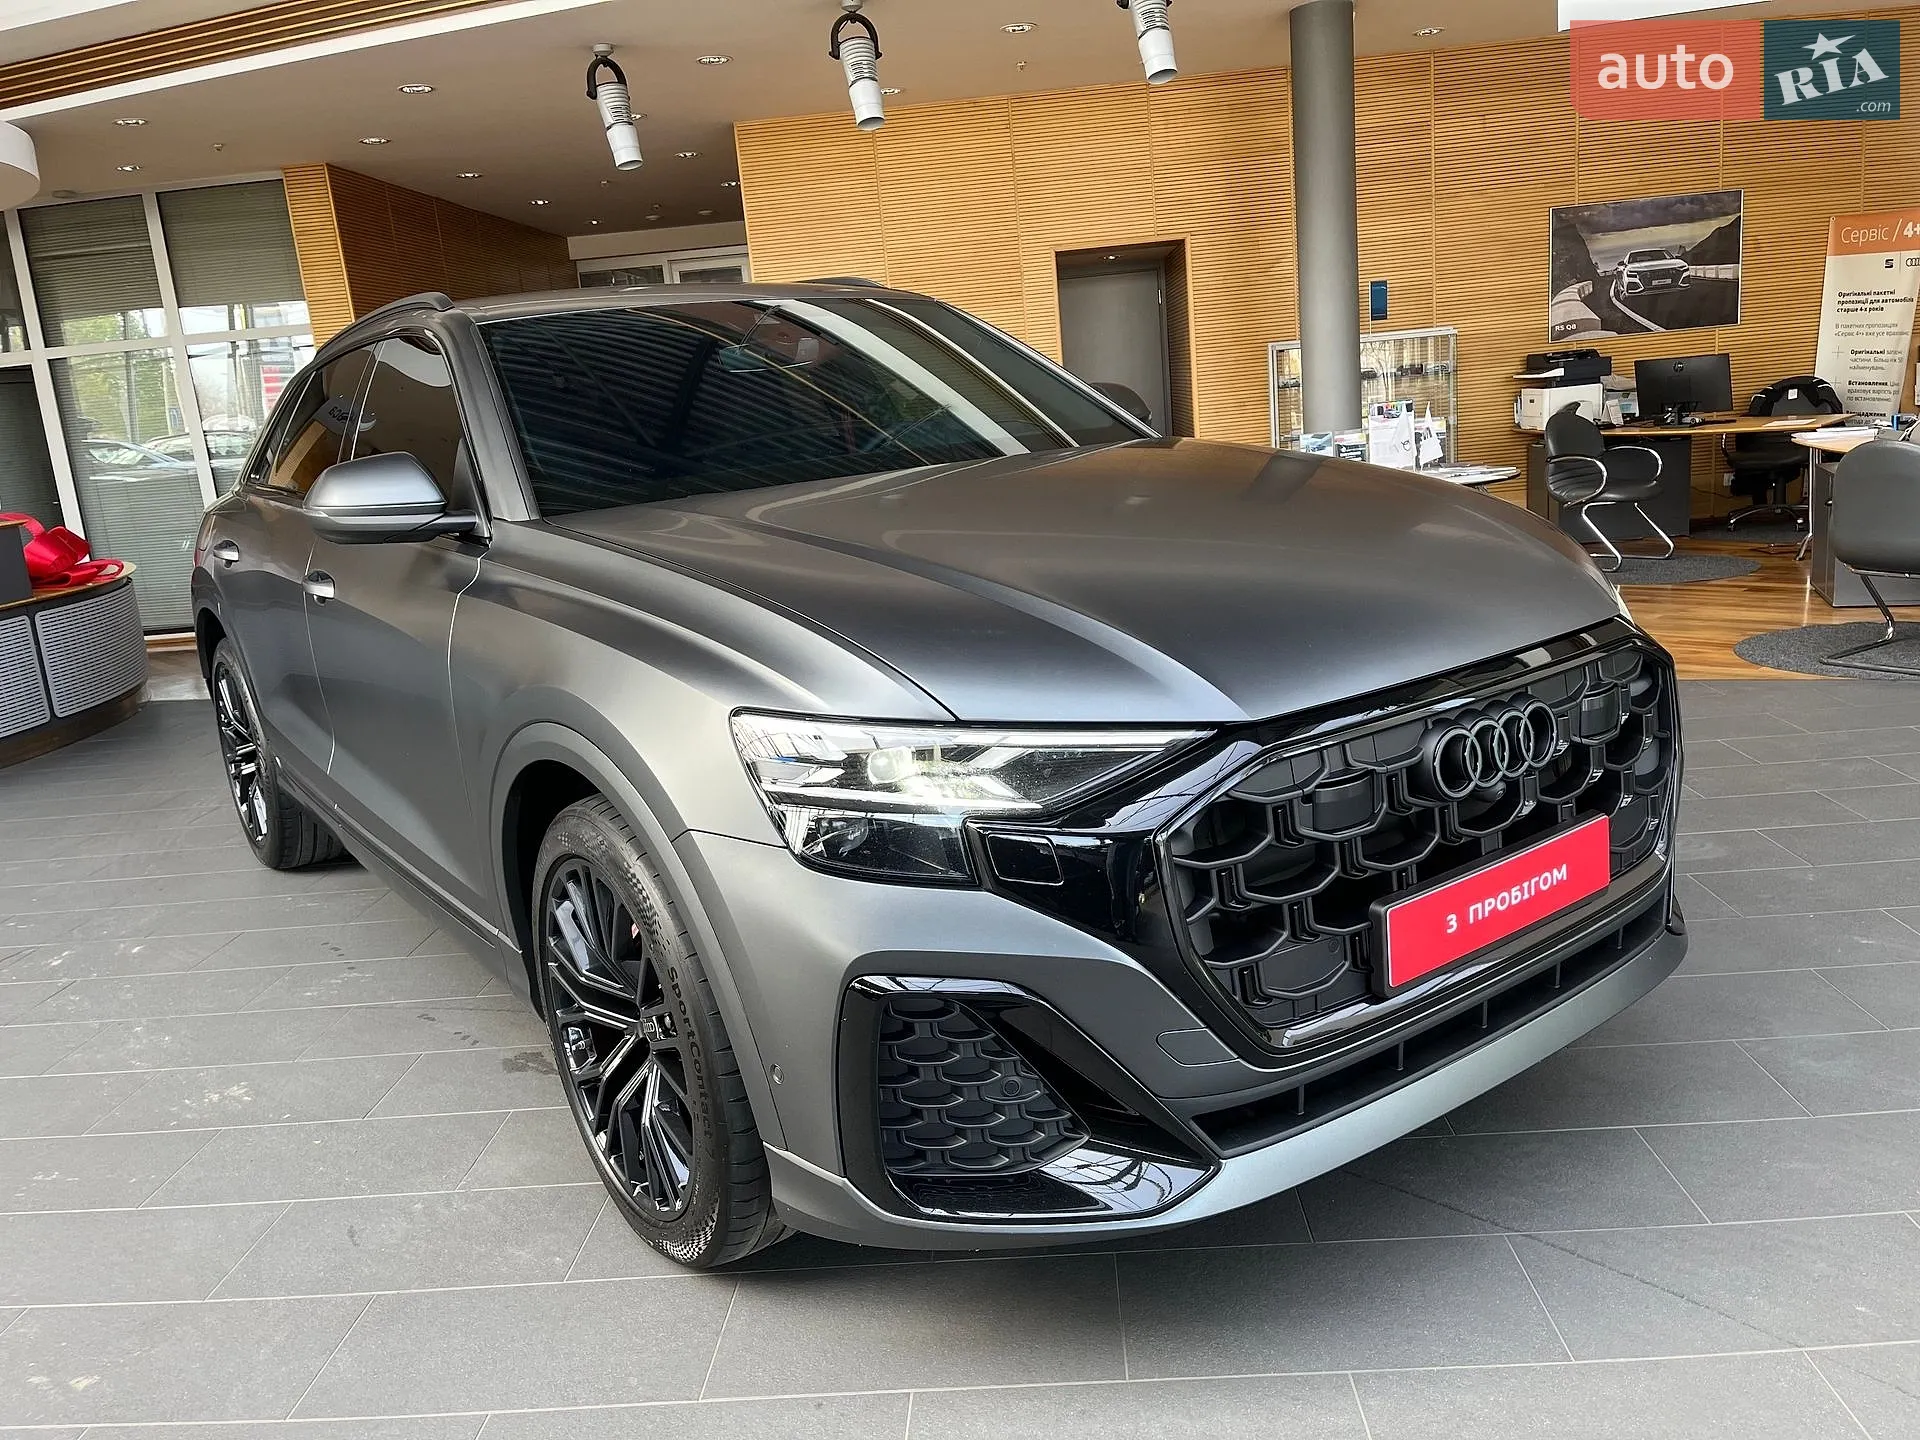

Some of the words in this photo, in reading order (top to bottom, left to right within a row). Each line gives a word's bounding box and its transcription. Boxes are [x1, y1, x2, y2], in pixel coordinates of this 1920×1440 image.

[1841, 225, 1889, 247] Сервіс
[1838, 290, 1872, 298] Оригінальні
[1837, 298, 1869, 306] пропозиції
[1837, 306, 1859, 314] старше
[1868, 305, 1884, 313] років
[1469, 863, 1568, 924] ПРОБІГОМ
[667, 966, 713, 1139] SportContact
